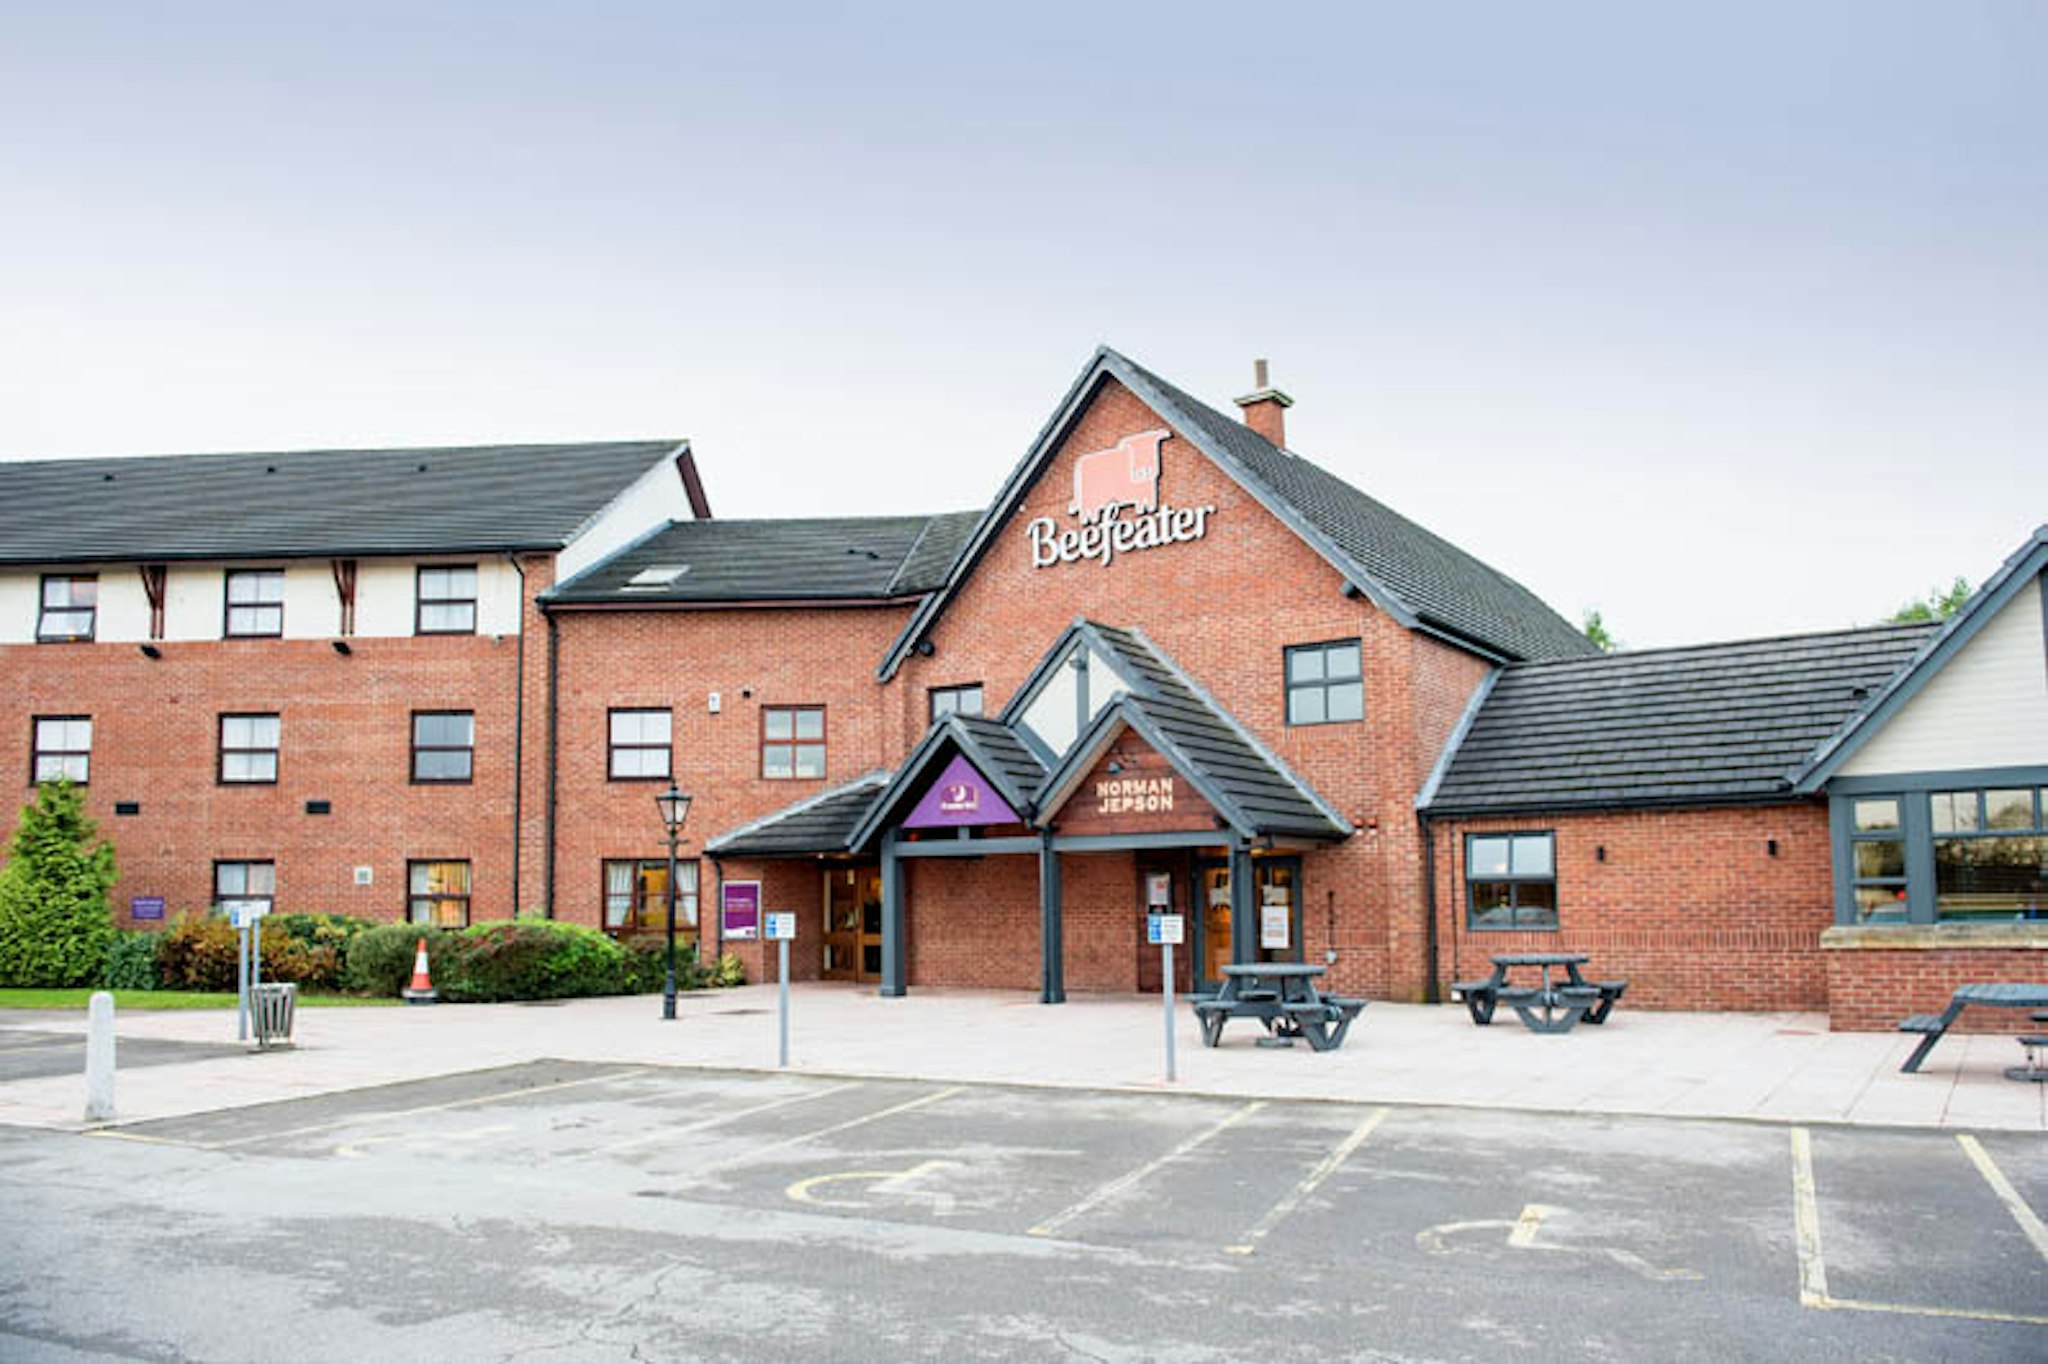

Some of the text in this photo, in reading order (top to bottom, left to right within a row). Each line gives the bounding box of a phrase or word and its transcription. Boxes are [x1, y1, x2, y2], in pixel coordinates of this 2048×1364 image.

[1027, 504, 1216, 567] Beefeater
[1096, 777, 1174, 797] NORMAN
[1097, 794, 1174, 813] JEPSON
